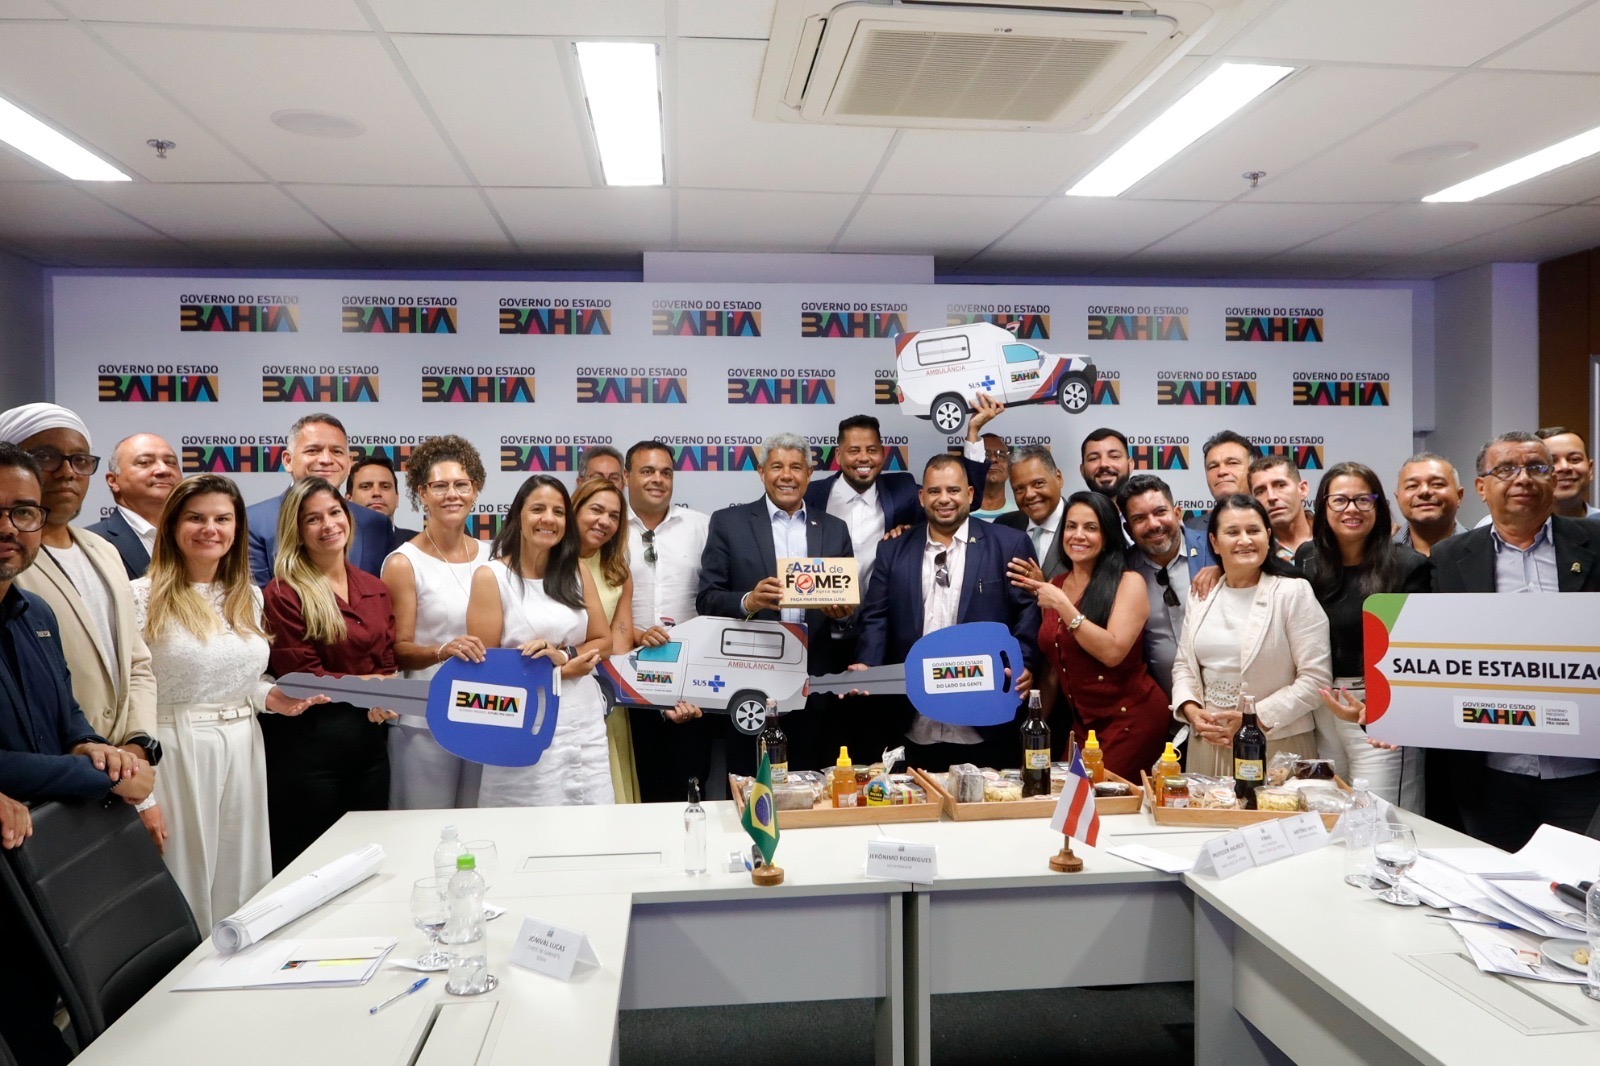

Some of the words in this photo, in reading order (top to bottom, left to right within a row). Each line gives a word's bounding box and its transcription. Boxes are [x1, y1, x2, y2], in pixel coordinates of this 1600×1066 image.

[180, 294, 235, 304] GOVERNO
[238, 295, 254, 304] DO
[257, 295, 299, 304] ESTADO
[342, 296, 395, 306] GOVERNO
[398, 296, 414, 306] DO
[416, 297, 457, 306] ESTADO
[499, 298, 551, 308] GOVERNO
[554, 298, 569, 308] DO
[572, 299, 612, 308] ESTADO
[652, 300, 703, 310] GOVERNO
[706, 301, 720, 310] DO
[723, 301, 762, 310] ESTADO
[801, 302, 850, 312] GOVERNO
[853, 303, 868, 312] DO
[870, 303, 908, 312] ESTADO
[947, 304, 995, 313] GOVERNO
[997, 304, 1012, 313] DO
[1014, 304, 1050, 314] ESTADO
[1088, 306, 1135, 315] GOVERNO
[1137, 306, 1151, 315] DO
[1154, 306, 1189, 316] ESTADO
[1225, 308, 1271, 316] GOVERNO
[1273, 308, 1287, 317] DO
[1289, 308, 1324, 317] ESTADO
[180, 305, 300, 332] BAHIA
[342, 307, 458, 334] BAHIA
[499, 309, 612, 335] BAHIA
[652, 311, 762, 337] BAHIA
[1088, 316, 1189, 341] BAHIA
[1225, 317, 1324, 342] BAHIA
[98, 364, 154, 374] GOVERNO
[157, 365, 173, 374] DO
[176, 365, 218, 374] ESTADO
[262, 365, 316, 375] GOVERNO
[319, 365, 335, 375] DO
[338, 366, 379, 375] ESTADO
[421, 366, 474, 376] GOVERNO
[477, 366, 493, 376] DO
[495, 366, 536, 376] ESTADO
[576, 367, 628, 376] GOVERNO
[631, 367, 646, 377] DO
[648, 367, 688, 377] ESTADO
[728, 368, 778, 378] GOVERNO
[781, 368, 796, 378] DO
[798, 369, 836, 378] ESTADO
[926, 365, 966, 376] AMBULÂNCIA
[1011, 371, 1040, 382] BAHIA
[1097, 371, 1120, 380] TADO
[1157, 371, 1204, 380] GOVERNO
[1206, 371, 1220, 380] DO
[1222, 372, 1257, 380] ESTADO
[1292, 372, 1338, 381] GOVERNO
[1341, 372, 1354, 381] DO
[1356, 372, 1390, 381] ESTADO
[98, 375, 218, 402] BAHIA
[262, 376, 379, 402] BAHIA
[421, 376, 536, 403] BAHIA
[576, 377, 688, 404] BAHIA
[968, 382, 981, 390] SUS
[728, 378, 836, 405] BAHIA
[1157, 381, 1257, 406] BAHIA
[1293, 382, 1390, 406] BAHIA
[182, 436, 237, 445] GOVERNO
[240, 436, 255, 445] DO
[400, 436, 415, 444] DO
[500, 436, 552, 444] GOVERNO
[556, 436, 570, 444] DO
[573, 436, 612, 444] ESTADO
[654, 436, 704, 444] GOVERNO
[707, 436, 721, 444] DO
[724, 436, 763, 444] ESTADO
[879, 436, 908, 445] STADO
[1014, 436, 1051, 444] ESTADO
[1138, 436, 1152, 444] DO
[1154, 436, 1189, 444] ESTADO
[1274, 436, 1287, 444] DO
[1290, 436, 1324, 444] ESTADO
[1131, 446, 1189, 470] HIA
[479, 504, 494, 513] DO
[1174, 501, 1204, 509] VERNO
[793, 562, 826, 573] Azul
[829, 565, 844, 574] de
[786, 574, 851, 590] FOME?
[728, 661, 775, 670] AMBULÂNCIA
[1393, 658, 1441, 674] SALA
[1446, 660, 1472, 676] DE
[932, 665, 984, 680] BAHIA
[636, 673, 674, 684] BAHIA
[692, 679, 707, 687] SUS
[456, 691, 520, 713] BAHIA
[1463, 708, 1536, 727] BAHIA
[900, 856, 932, 864] RODRIGUES
[549, 942, 566, 952] LUCAS
